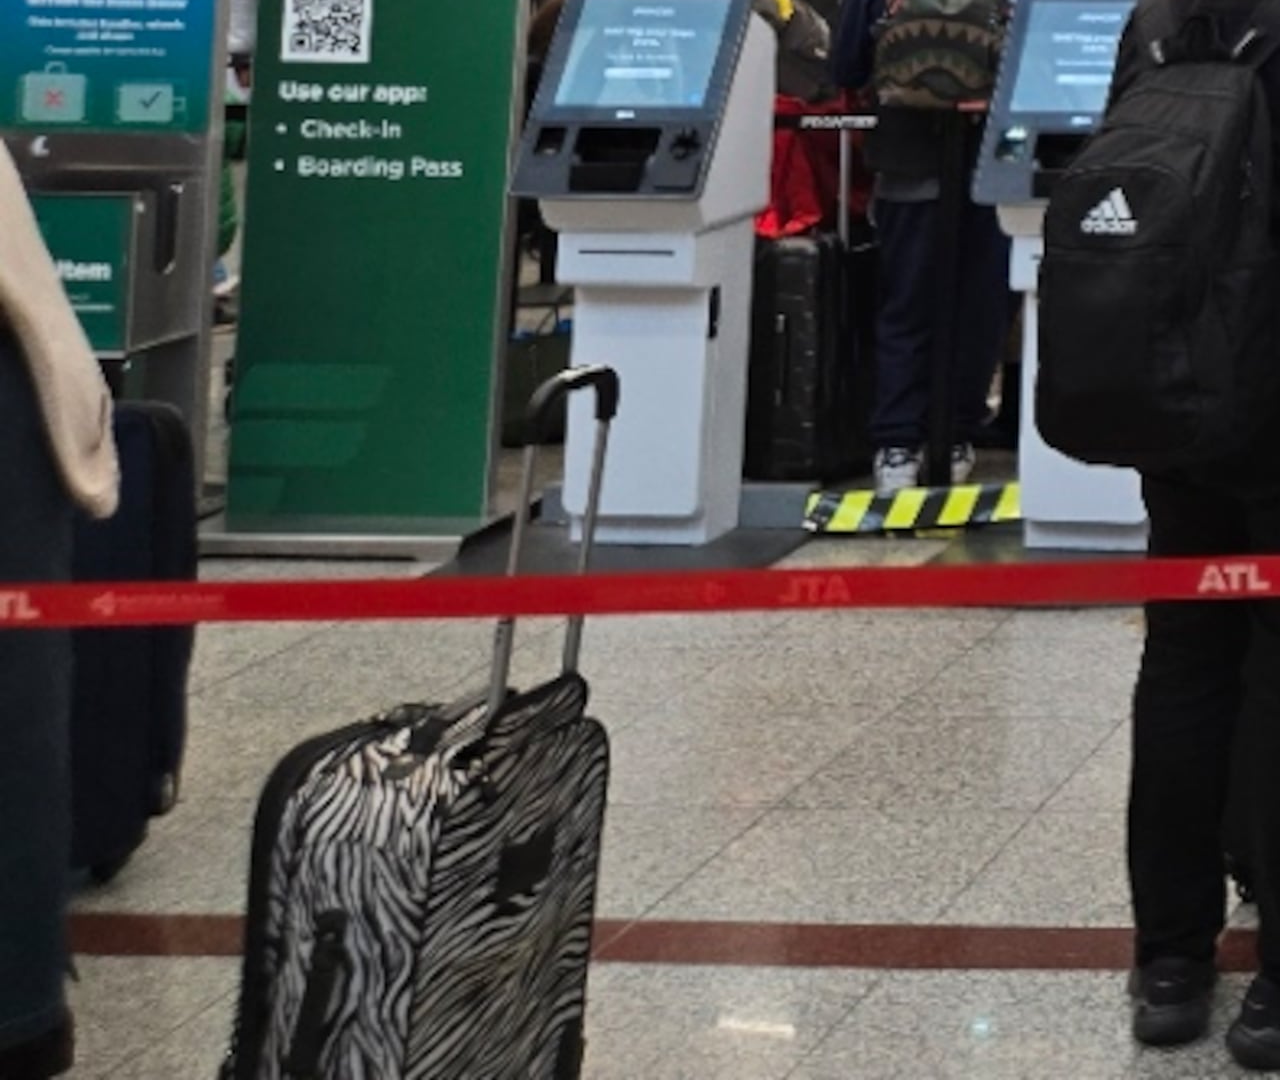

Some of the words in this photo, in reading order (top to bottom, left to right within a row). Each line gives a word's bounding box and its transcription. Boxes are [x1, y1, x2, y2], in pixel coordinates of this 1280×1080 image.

[278, 81, 324, 102] Use
[328, 85, 369, 101] our
[373, 85, 428, 105] app:
[300, 120, 402, 138] Check-In
[297, 155, 404, 181] Boarding
[410, 156, 463, 177] Pass
[1197, 563, 1271, 593] ATL
